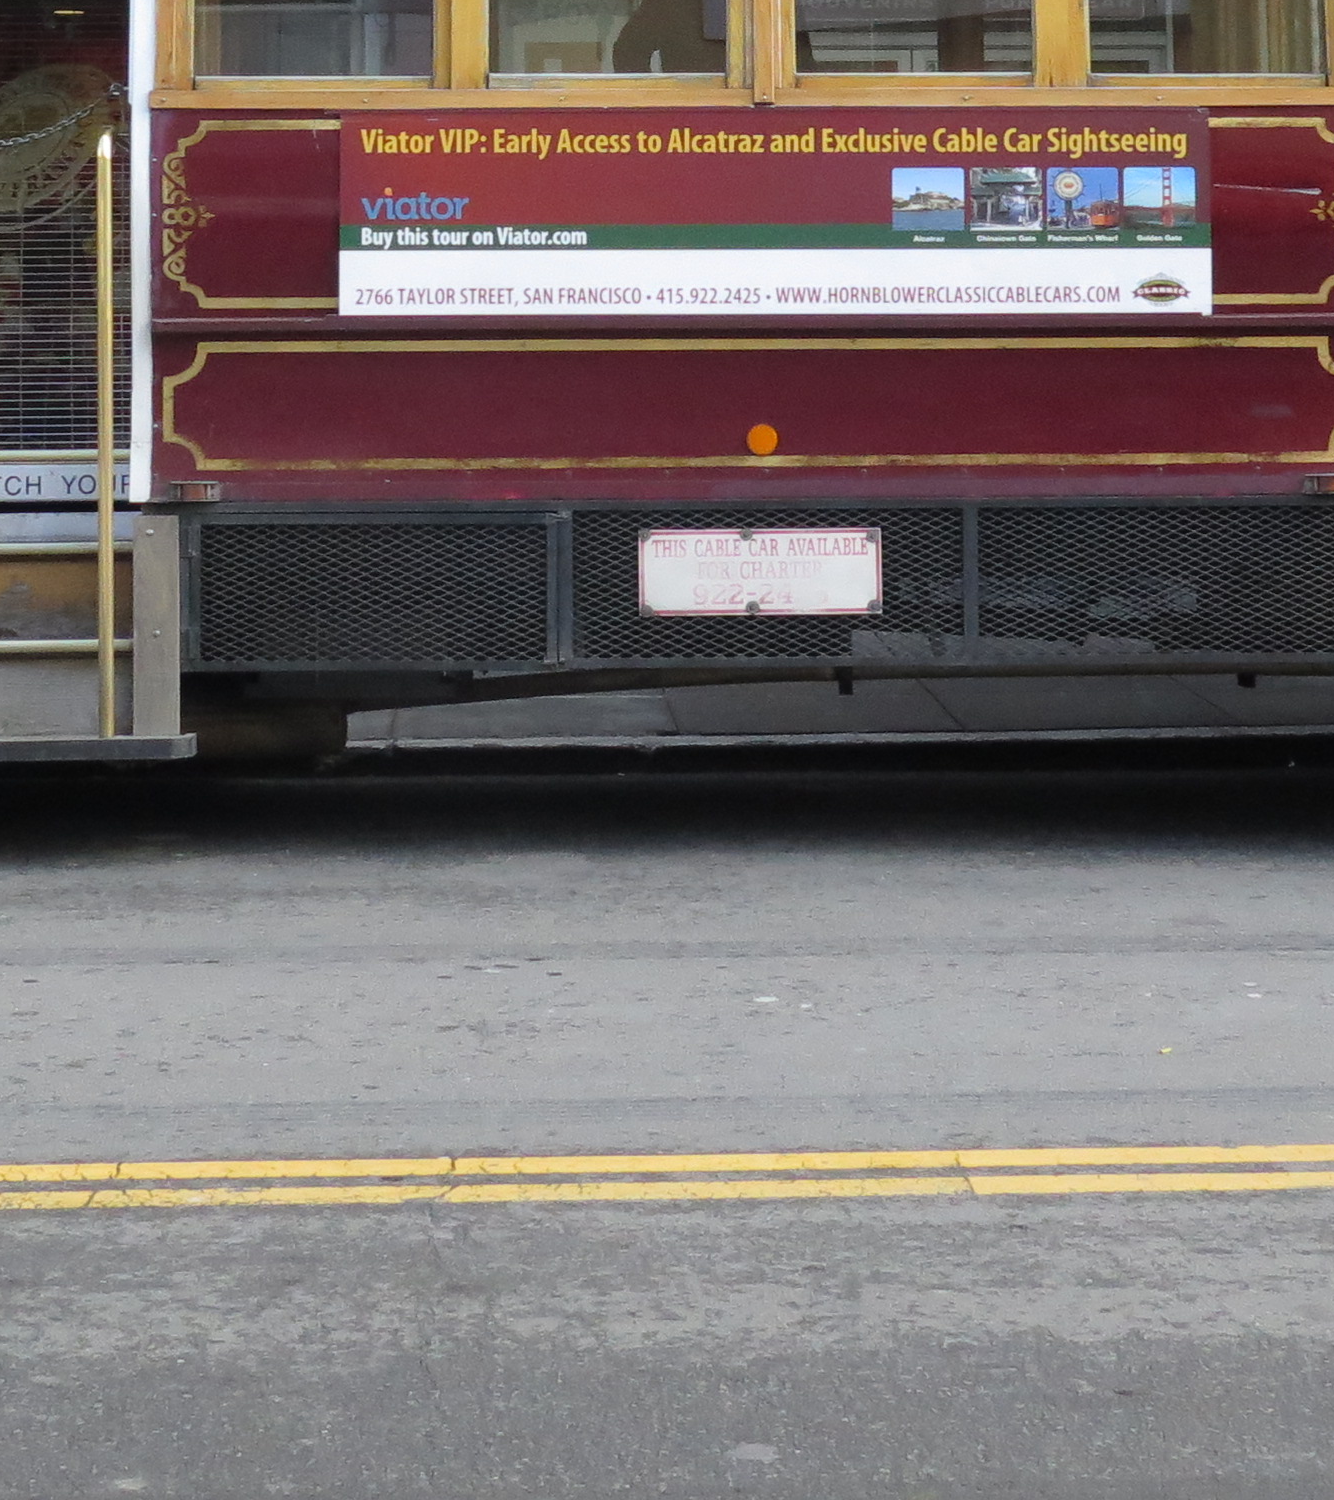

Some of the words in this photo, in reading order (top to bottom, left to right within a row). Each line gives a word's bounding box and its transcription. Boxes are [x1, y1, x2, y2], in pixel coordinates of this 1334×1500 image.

[360, 128, 434, 154] Viator
[439, 128, 487, 154] VIP:
[493, 128, 552, 160] Early
[556, 128, 632, 154] Access
[637, 132, 662, 154] to
[667, 128, 765, 154] Alcatraz
[770, 128, 816, 154] and
[821, 128, 927, 154] Exclusive
[932, 128, 997, 154] Cable
[1003, 128, 1042, 154] Car
[1046, 127, 1188, 159] Sightseeing
[360, 187, 470, 221] viator
[360, 228, 394, 250] Buy
[396, 228, 430, 246] this
[433, 229, 469, 246] tour
[472, 232, 494, 246] on
[496, 227, 588, 246] Viator.com
[355, 288, 394, 306] 2766
[397, 288, 456, 306] TAYLOR
[460, 288, 519, 308] STREET,
[523, 288, 553, 306] SAN
[557, 287, 642, 306] FRANCISCO
[655, 287, 762, 305] 415.922.2425
[775, 285, 1121, 305] WWW.HORNBLOWERCLASSICCABLECARS.COM
[652, 538, 687, 558] THIS
[694, 537, 742, 558] CABLE
[748, 536, 780, 556] CAR
[787, 535, 869, 556] AVAILABLE
